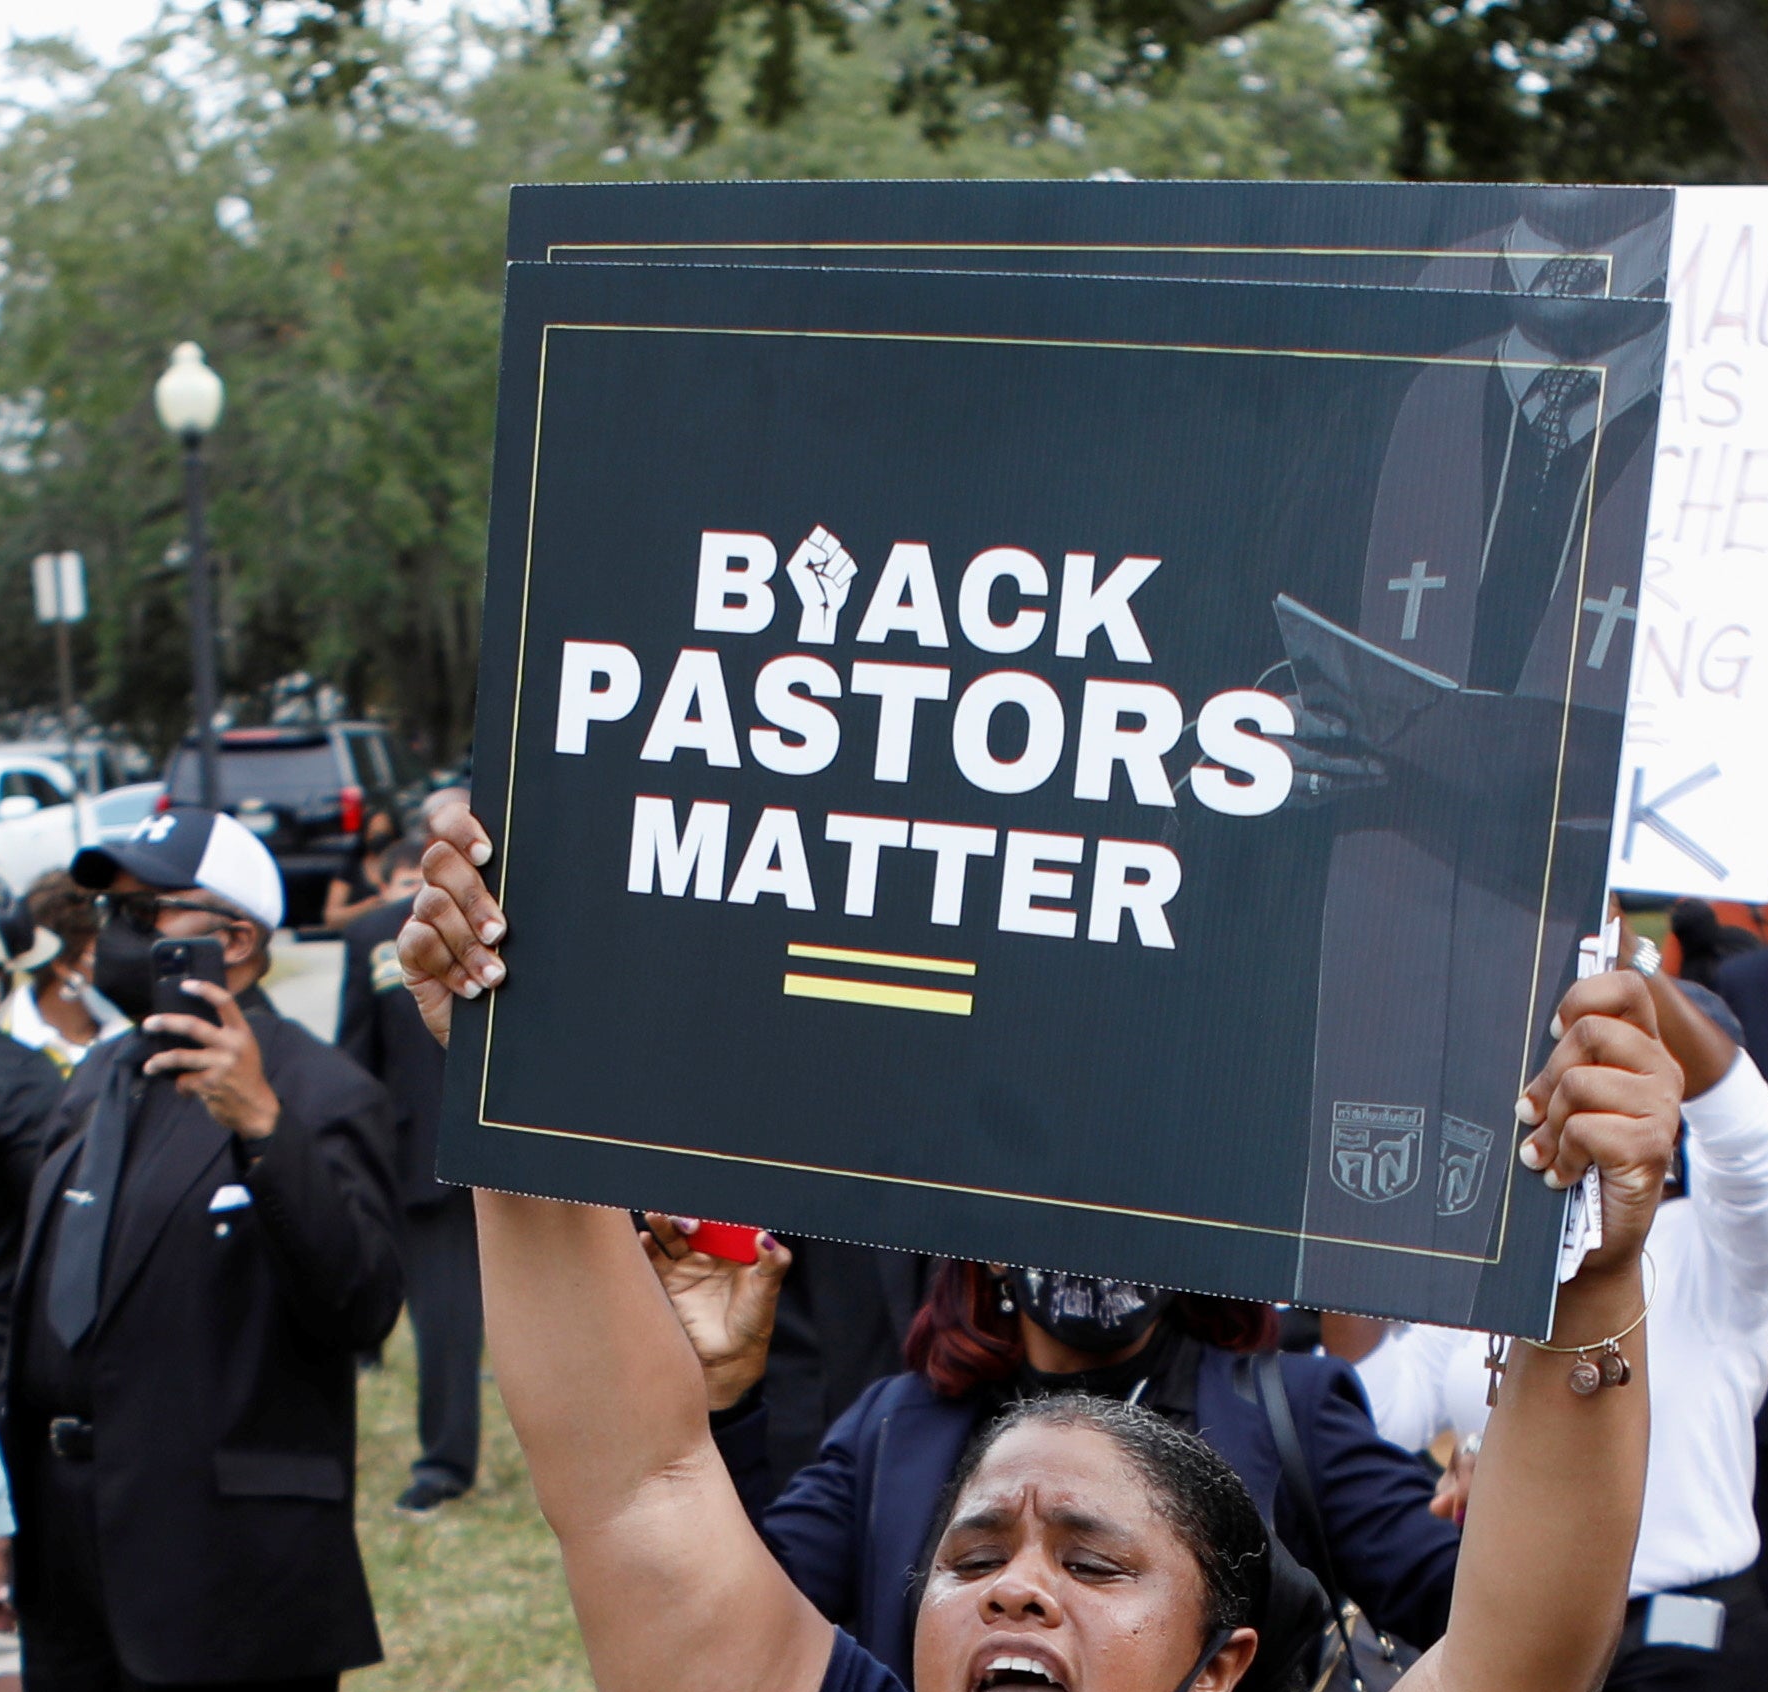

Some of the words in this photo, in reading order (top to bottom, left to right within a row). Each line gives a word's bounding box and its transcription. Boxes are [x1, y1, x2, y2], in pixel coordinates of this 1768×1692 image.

[694, 525, 1162, 664] BACK
[554, 641, 1296, 817] PASTORS
[627, 795, 1183, 949] MATTER
